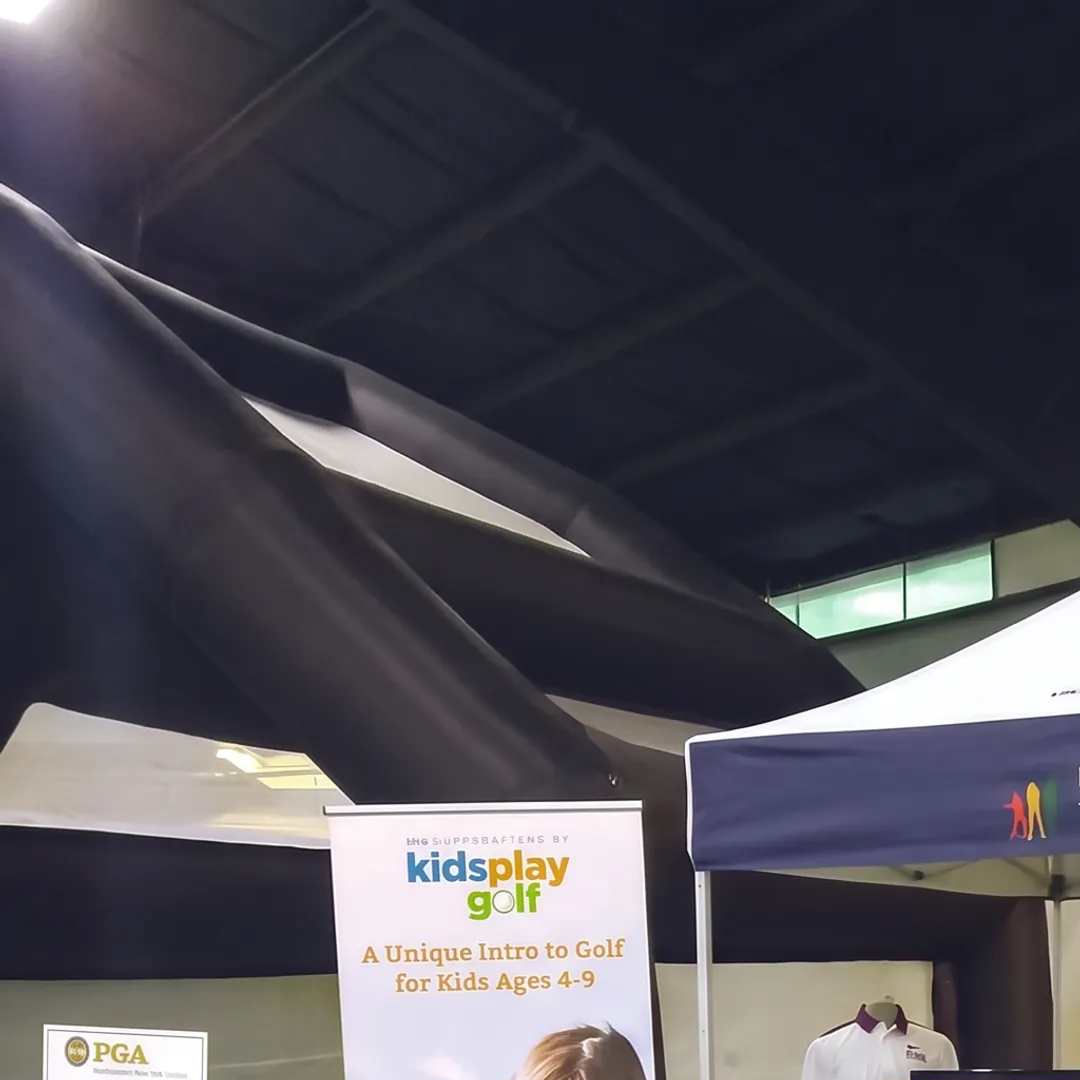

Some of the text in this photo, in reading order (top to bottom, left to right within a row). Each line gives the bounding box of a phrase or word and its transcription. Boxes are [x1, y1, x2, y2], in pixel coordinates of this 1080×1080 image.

[406, 850, 570, 888] kidsplay
[467, 882, 541, 921] golf
[361, 938, 626, 969] A Unique Intro to Golf
[395, 969, 595, 996] for Kids Ages 4-9
[93, 1042, 149, 1065] PGA
